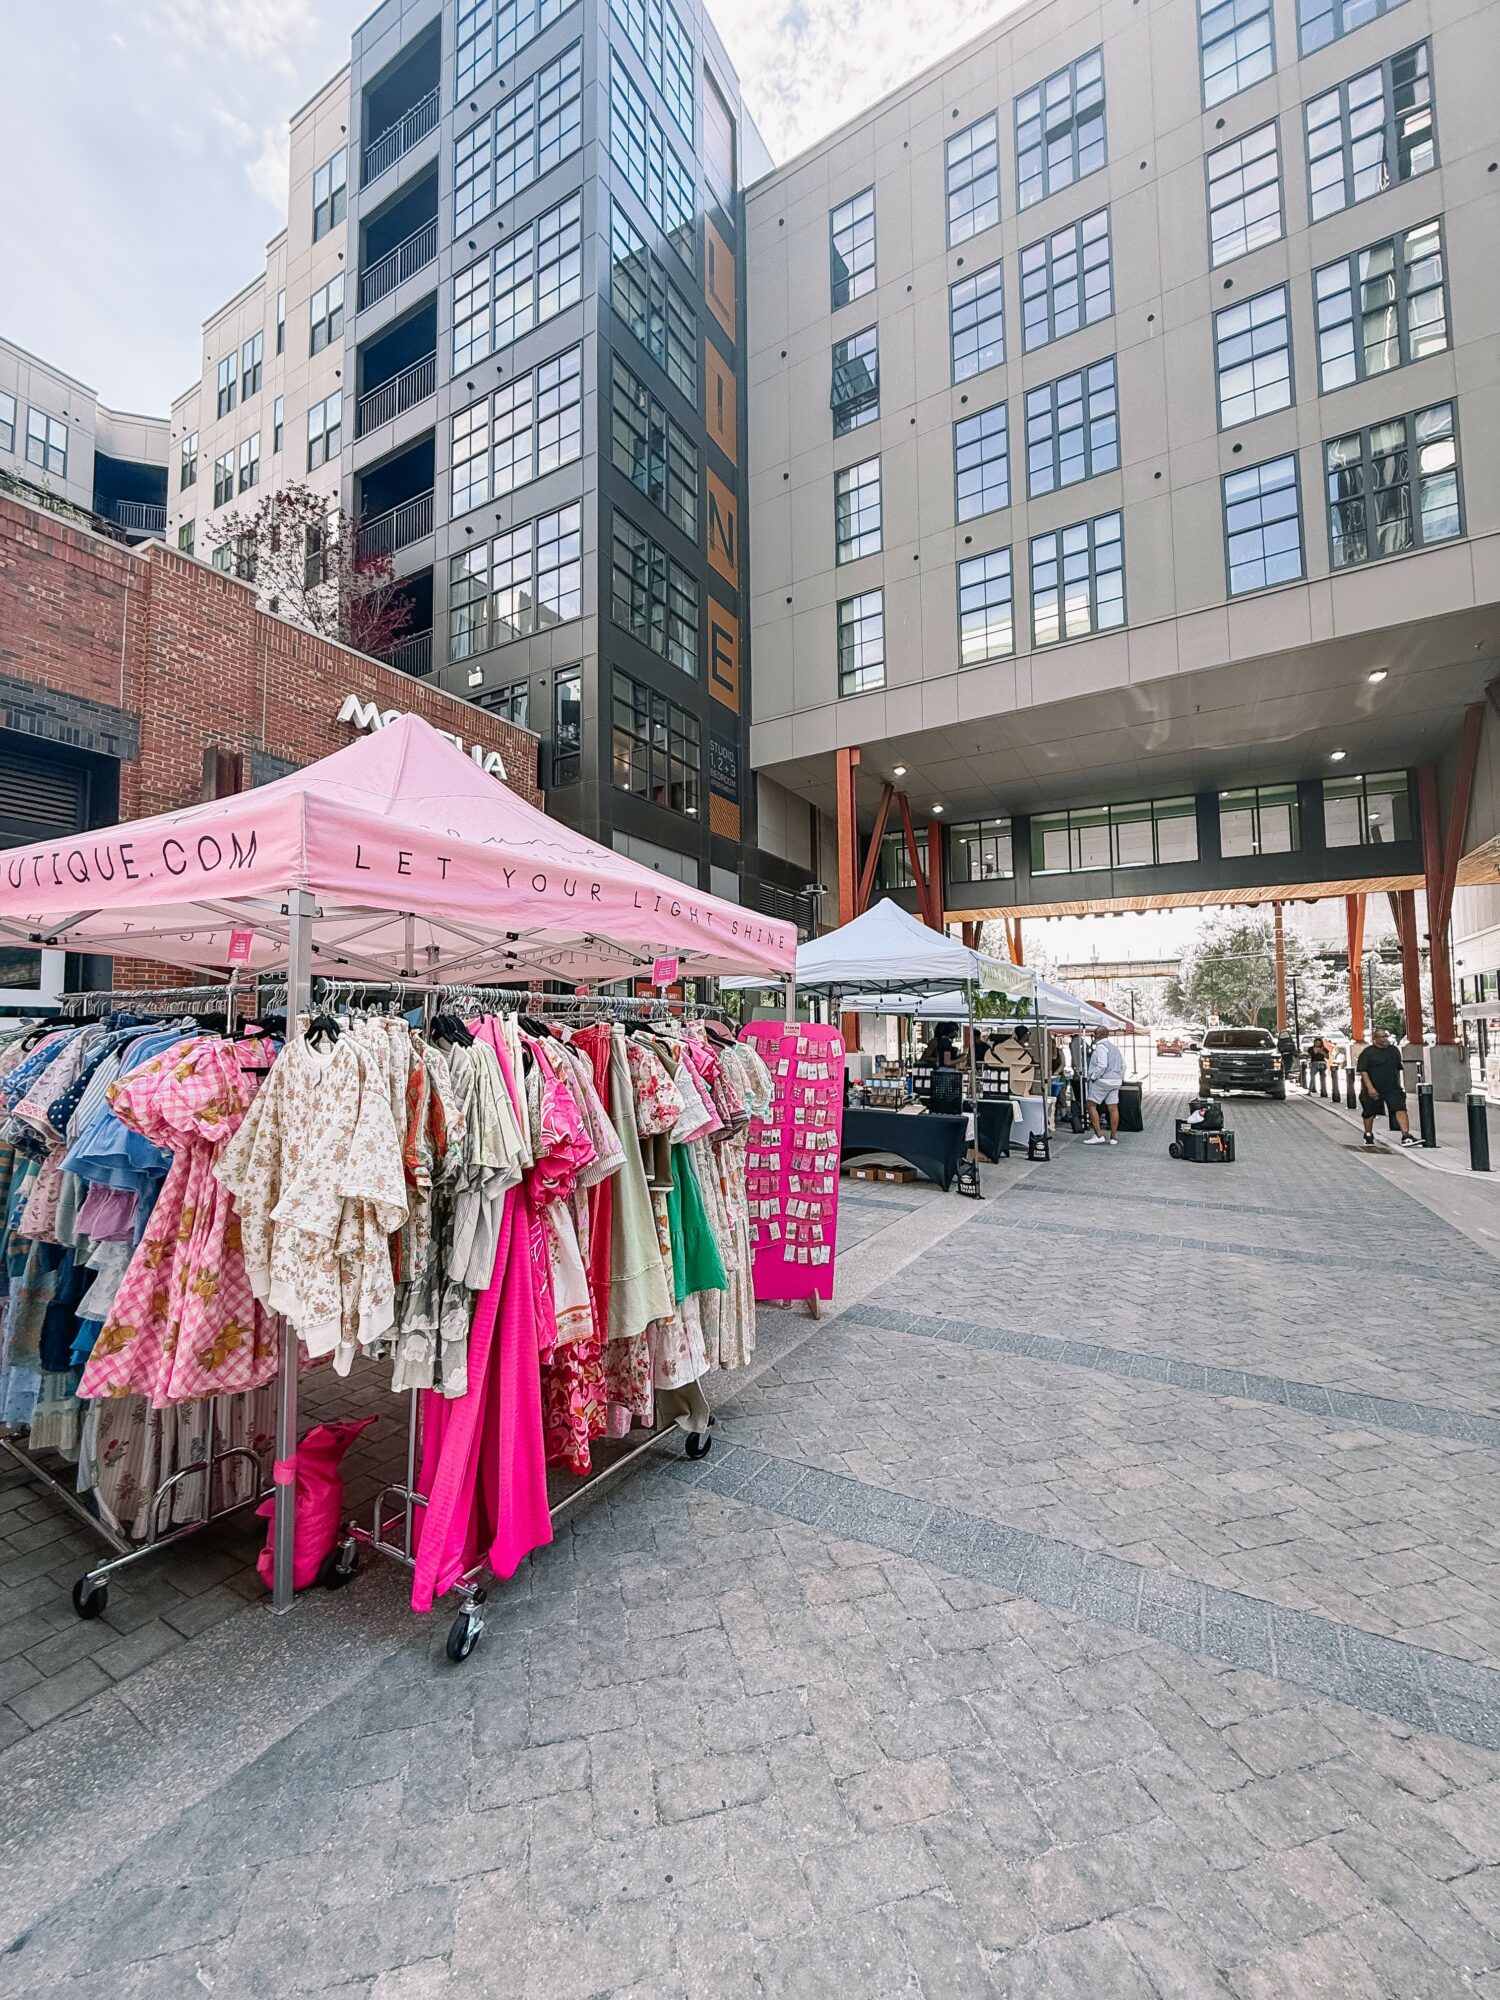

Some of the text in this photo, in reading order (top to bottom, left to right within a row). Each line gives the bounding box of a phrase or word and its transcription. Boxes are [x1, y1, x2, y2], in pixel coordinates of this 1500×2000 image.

[0, 830, 258, 889] UTIQUE.COM
[355, 844, 785, 949] LET YOUR LIGHT SHINE
